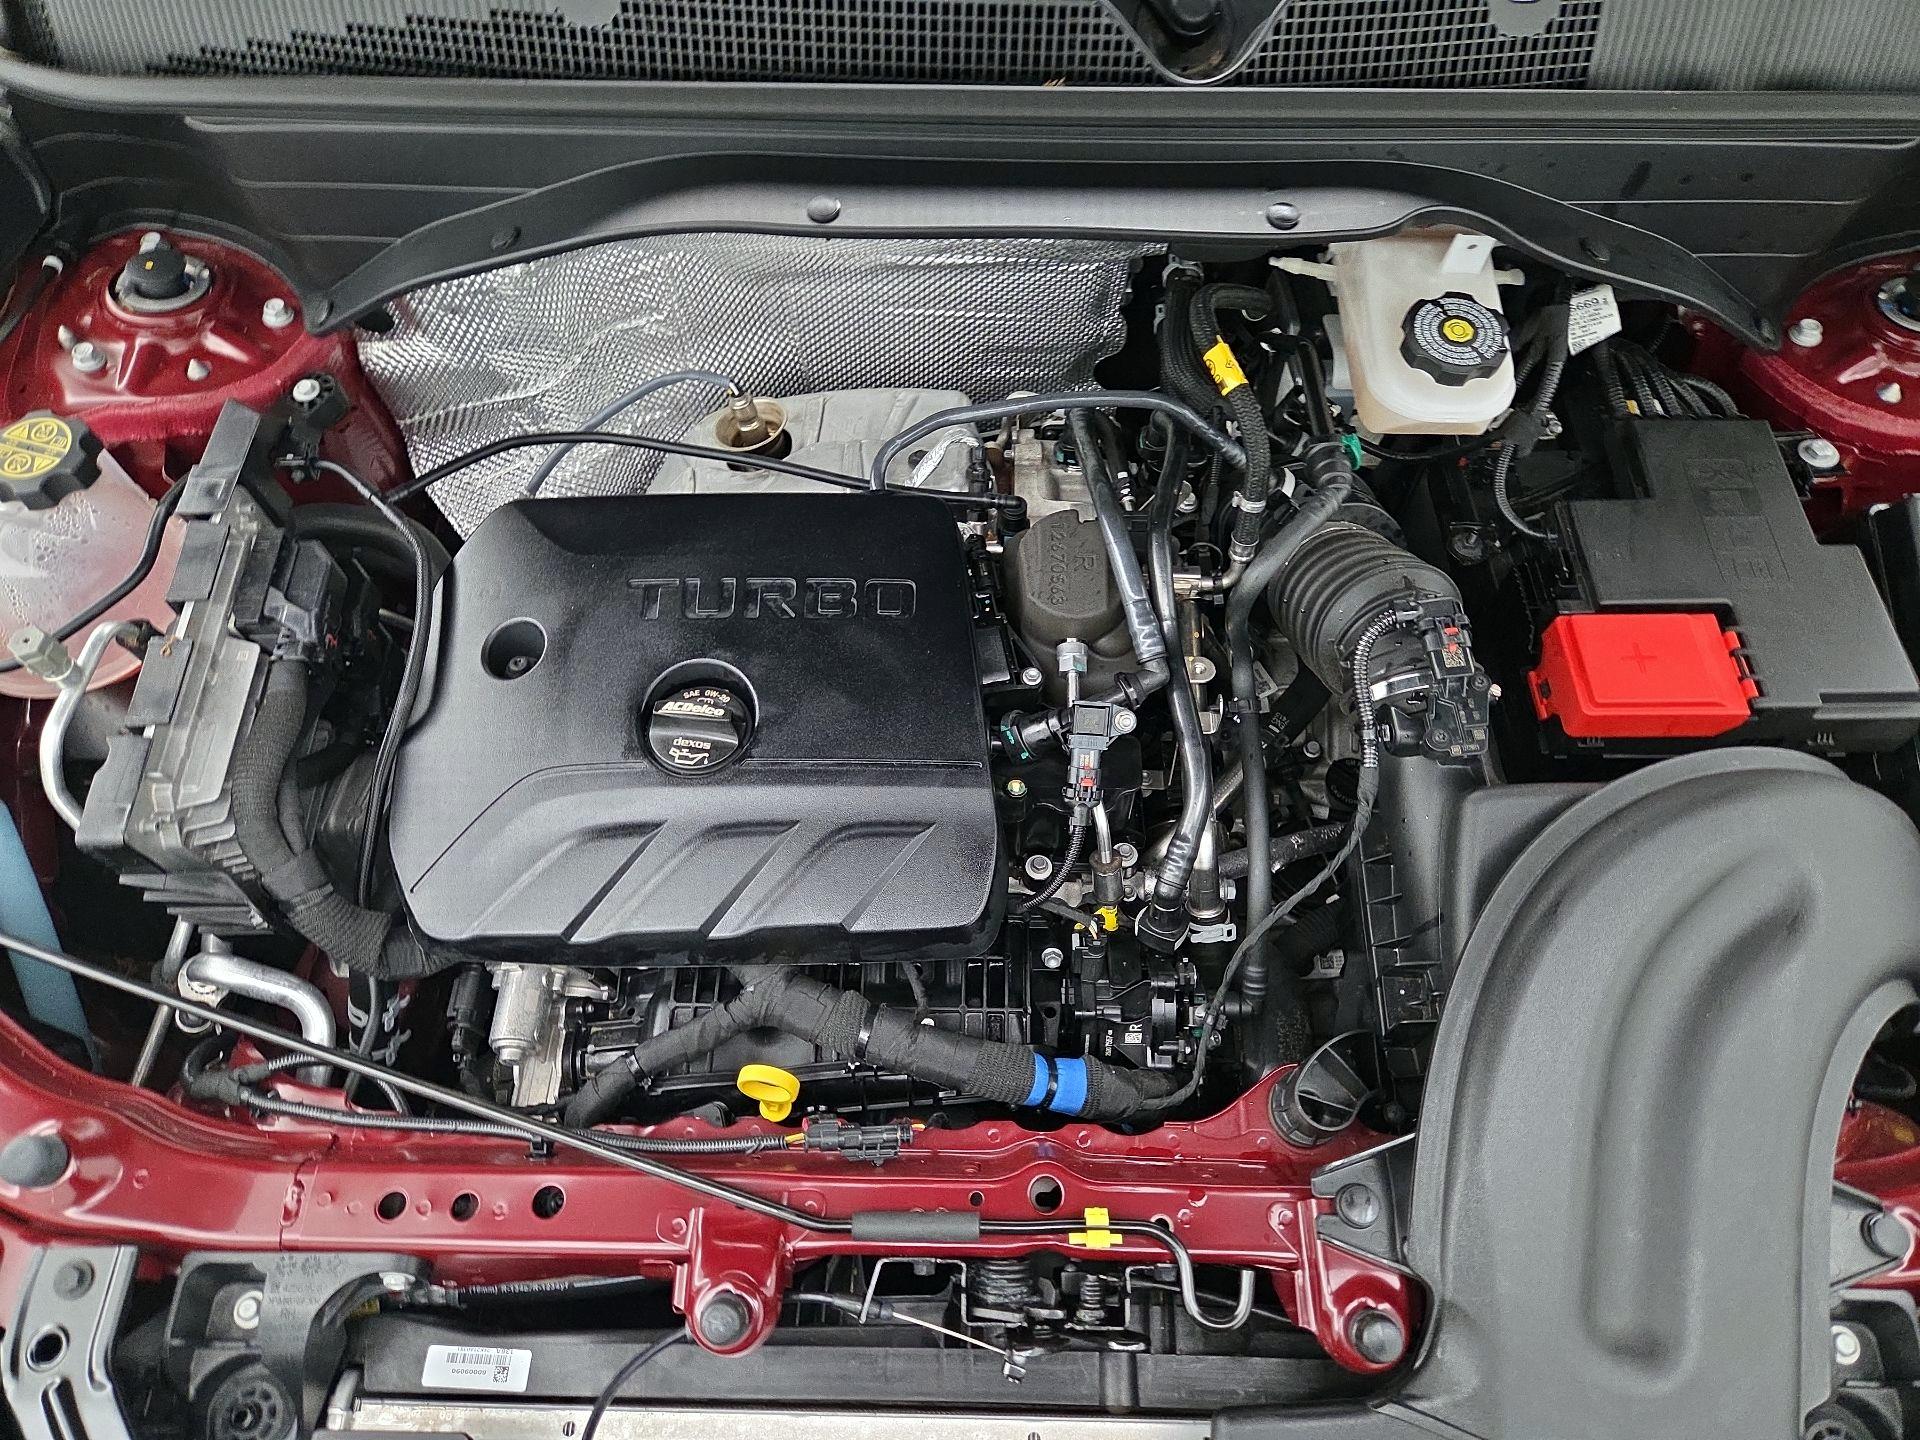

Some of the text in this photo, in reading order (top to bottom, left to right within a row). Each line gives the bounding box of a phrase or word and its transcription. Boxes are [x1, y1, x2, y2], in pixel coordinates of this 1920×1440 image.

[1074, 554, 1095, 571] R
[628, 577, 917, 619] TURBO
[683, 689, 731, 703] SAE 0W-20
[661, 701, 725, 716] ACDelco
[672, 737, 711, 749] dexos
